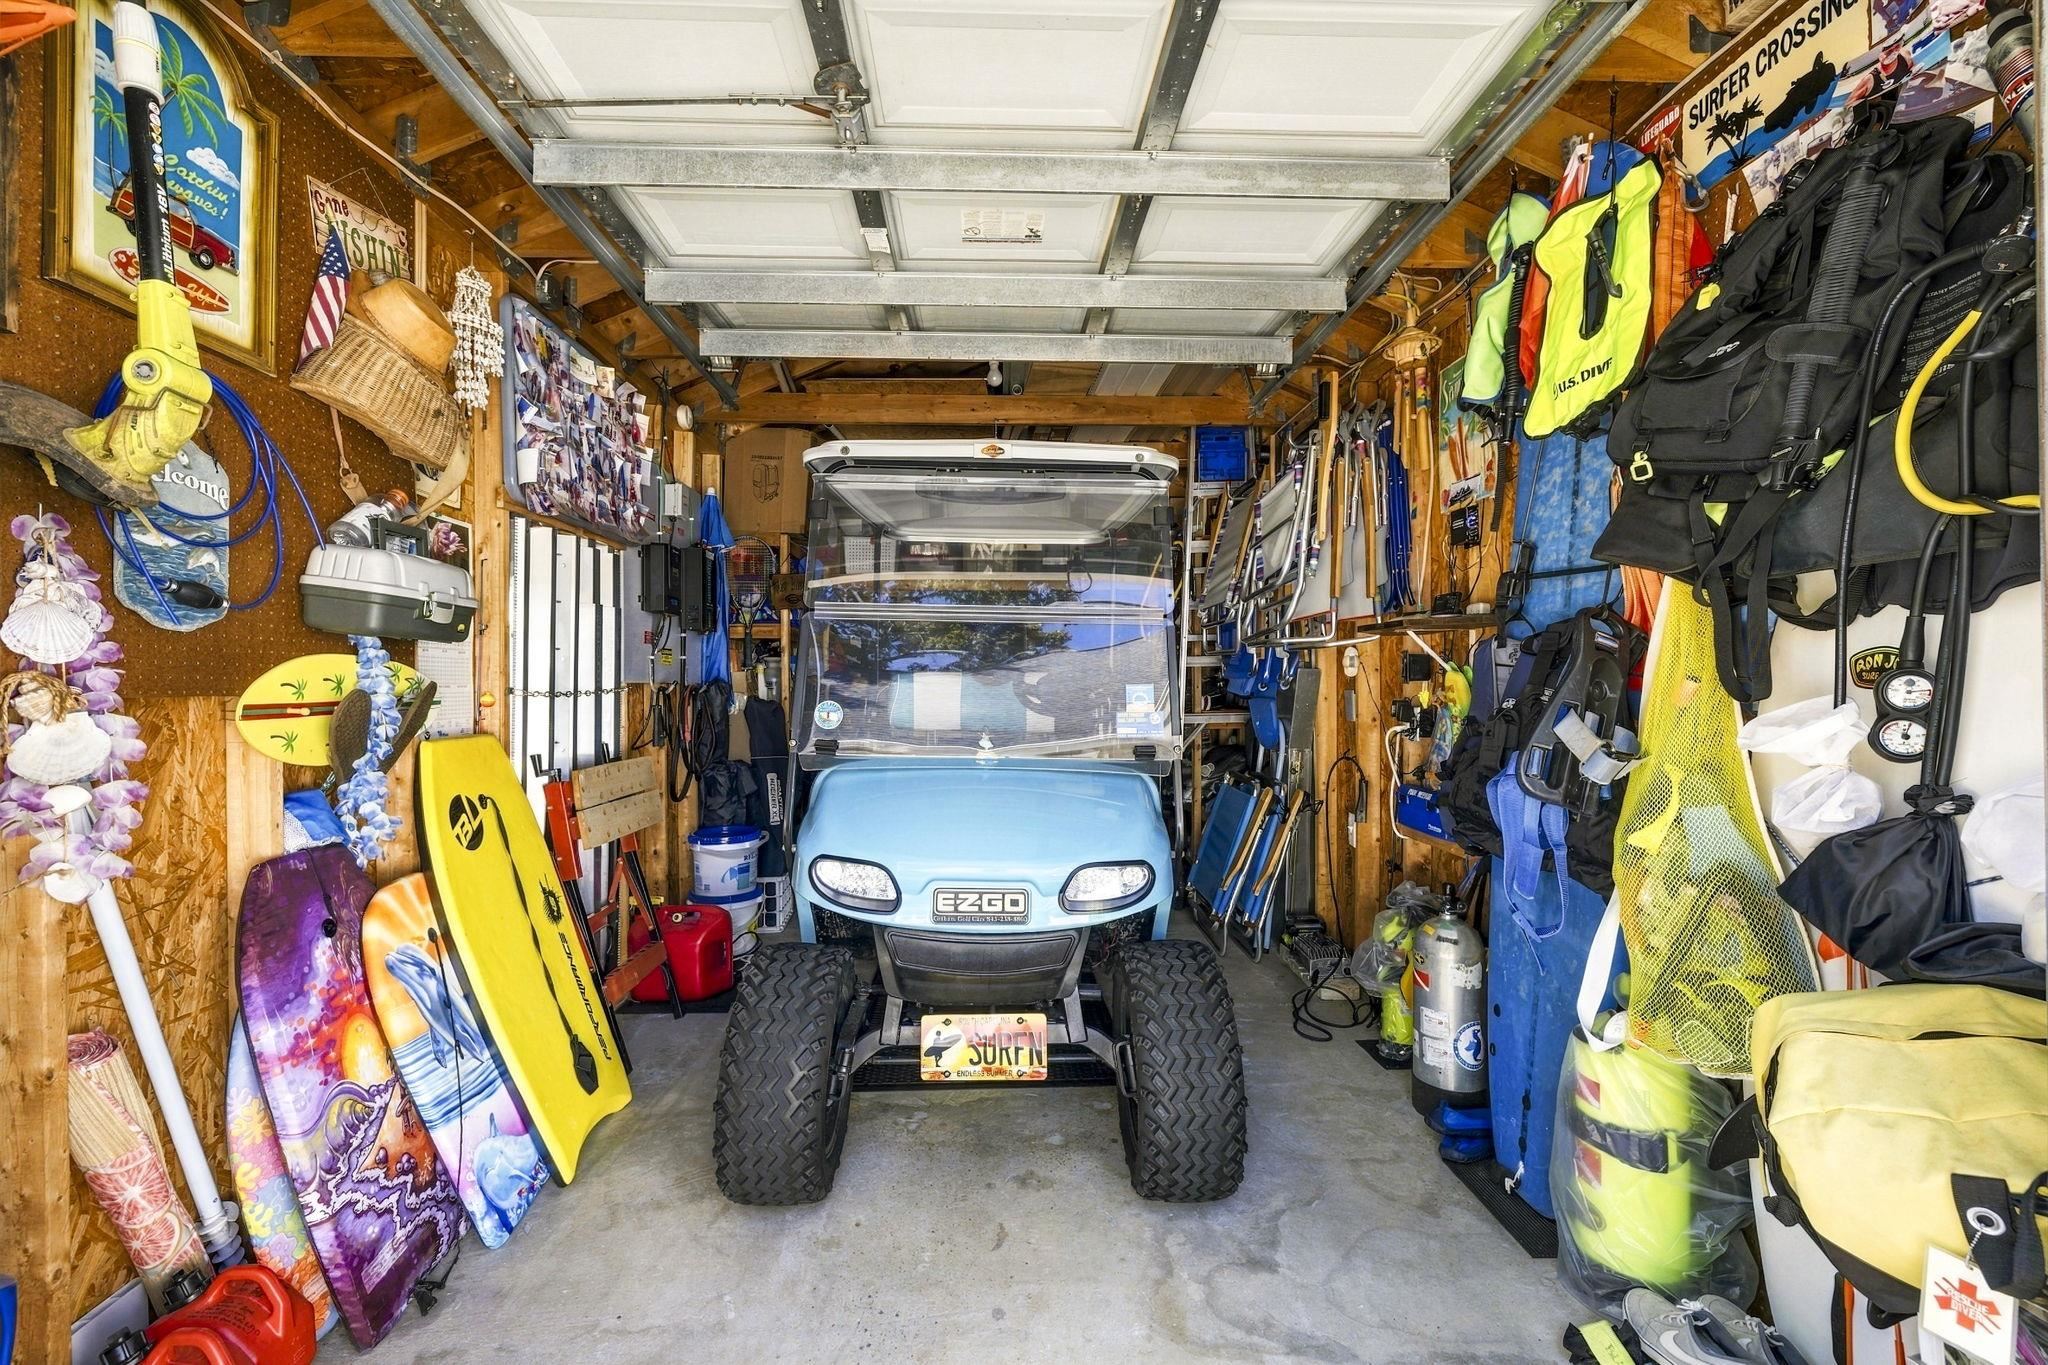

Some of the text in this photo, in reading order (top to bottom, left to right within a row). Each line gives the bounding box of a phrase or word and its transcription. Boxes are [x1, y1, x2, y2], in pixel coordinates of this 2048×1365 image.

[1689, 60, 1750, 130] SURFER
[1641, 105, 1680, 147] LIFEGUARD
[156, 183, 169, 214] 18V
[160, 218, 175, 271] Lithium
[1856, 653, 1884, 673] RON
[956, 1069, 1013, 1078] ENDLESS SUMMER
